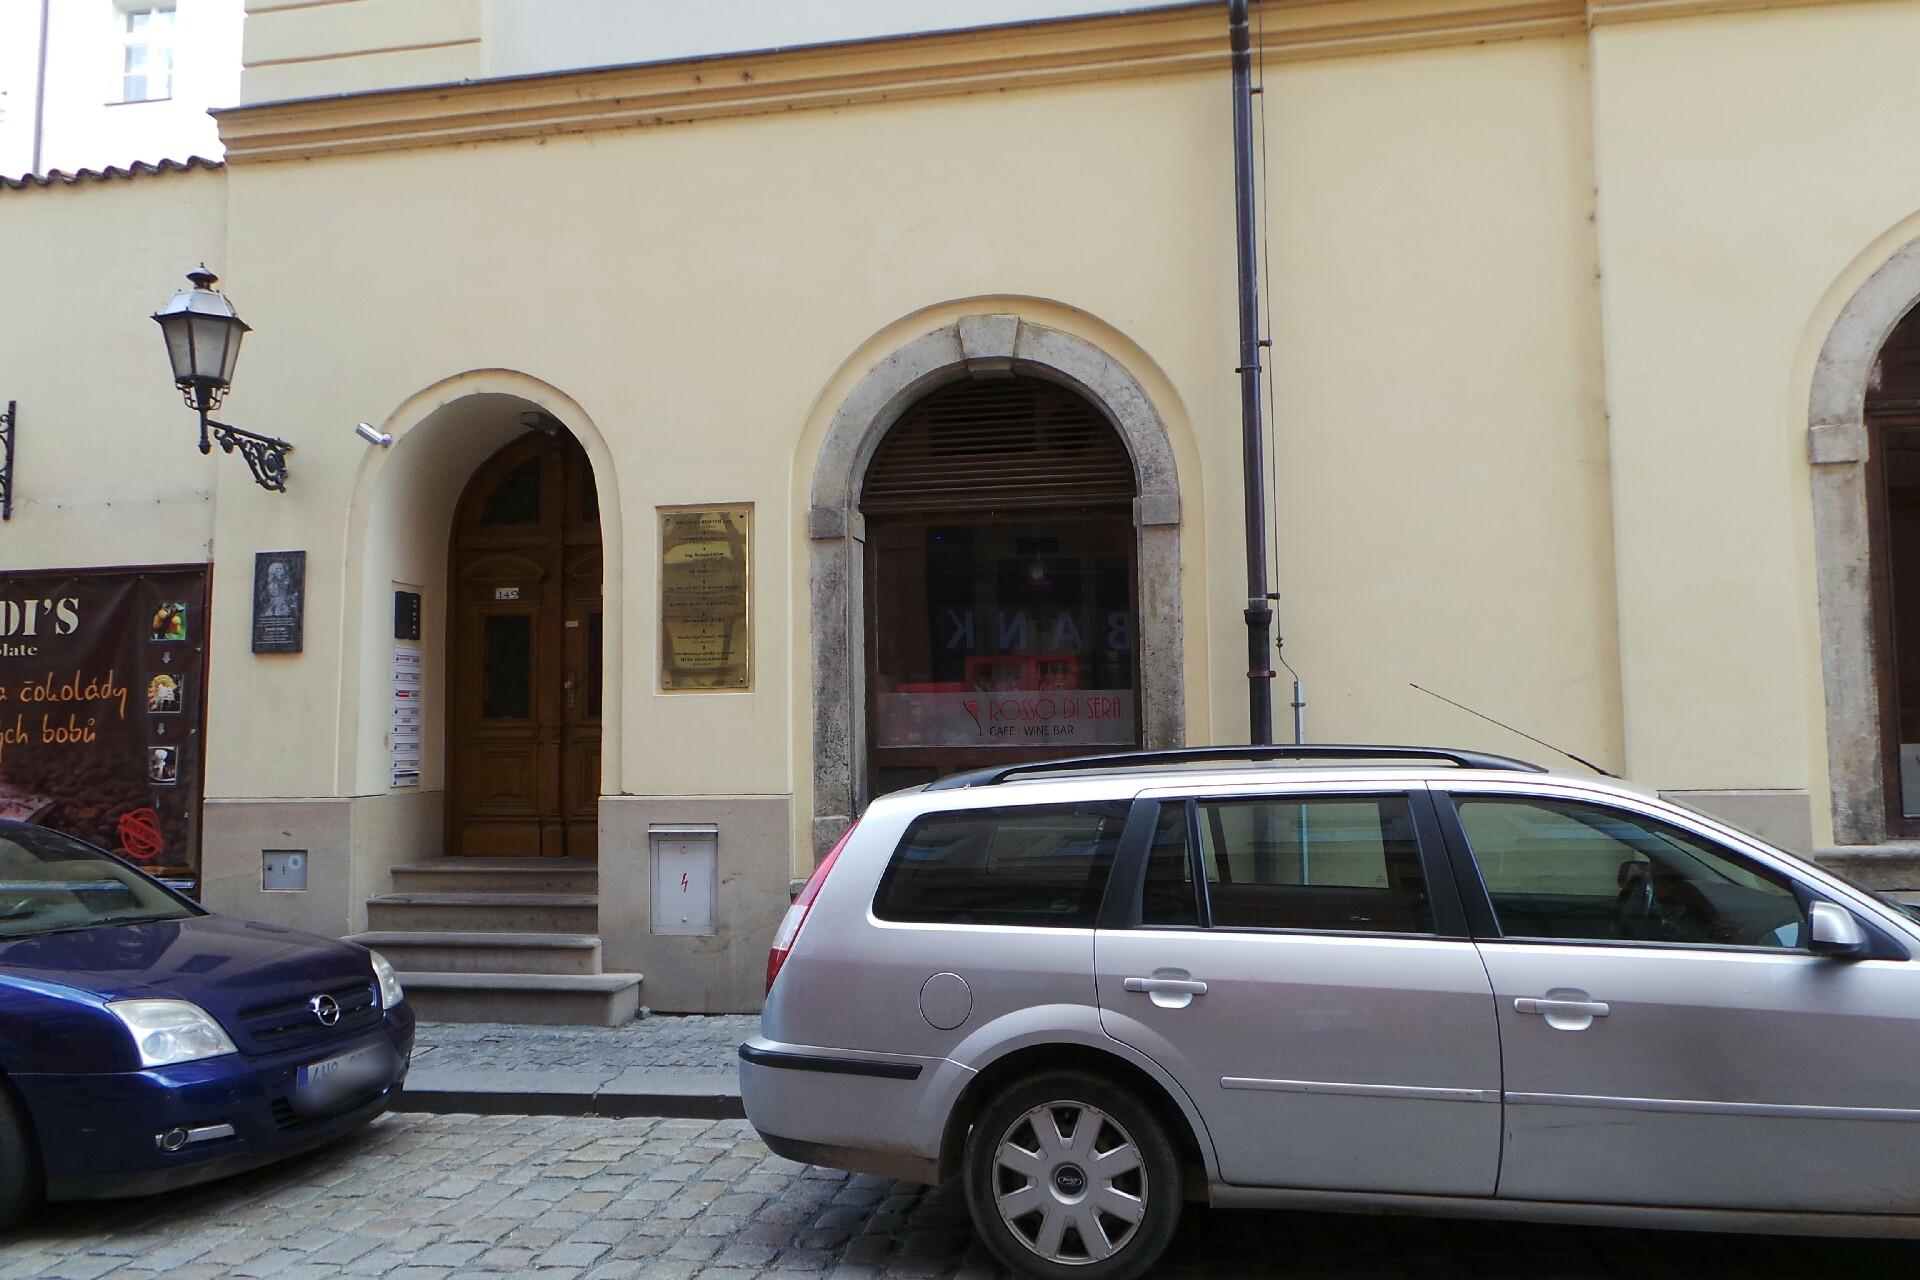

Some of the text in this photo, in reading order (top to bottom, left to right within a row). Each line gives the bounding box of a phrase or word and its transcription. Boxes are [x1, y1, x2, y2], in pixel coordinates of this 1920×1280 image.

[0, 643, 39, 657] late
[20, 669, 127, 720] čokolády
[989, 696, 1121, 720] ROSSO DI SERA
[42, 713, 96, 743] bobů
[989, 724, 1075, 736] CAFE WINE BAR
